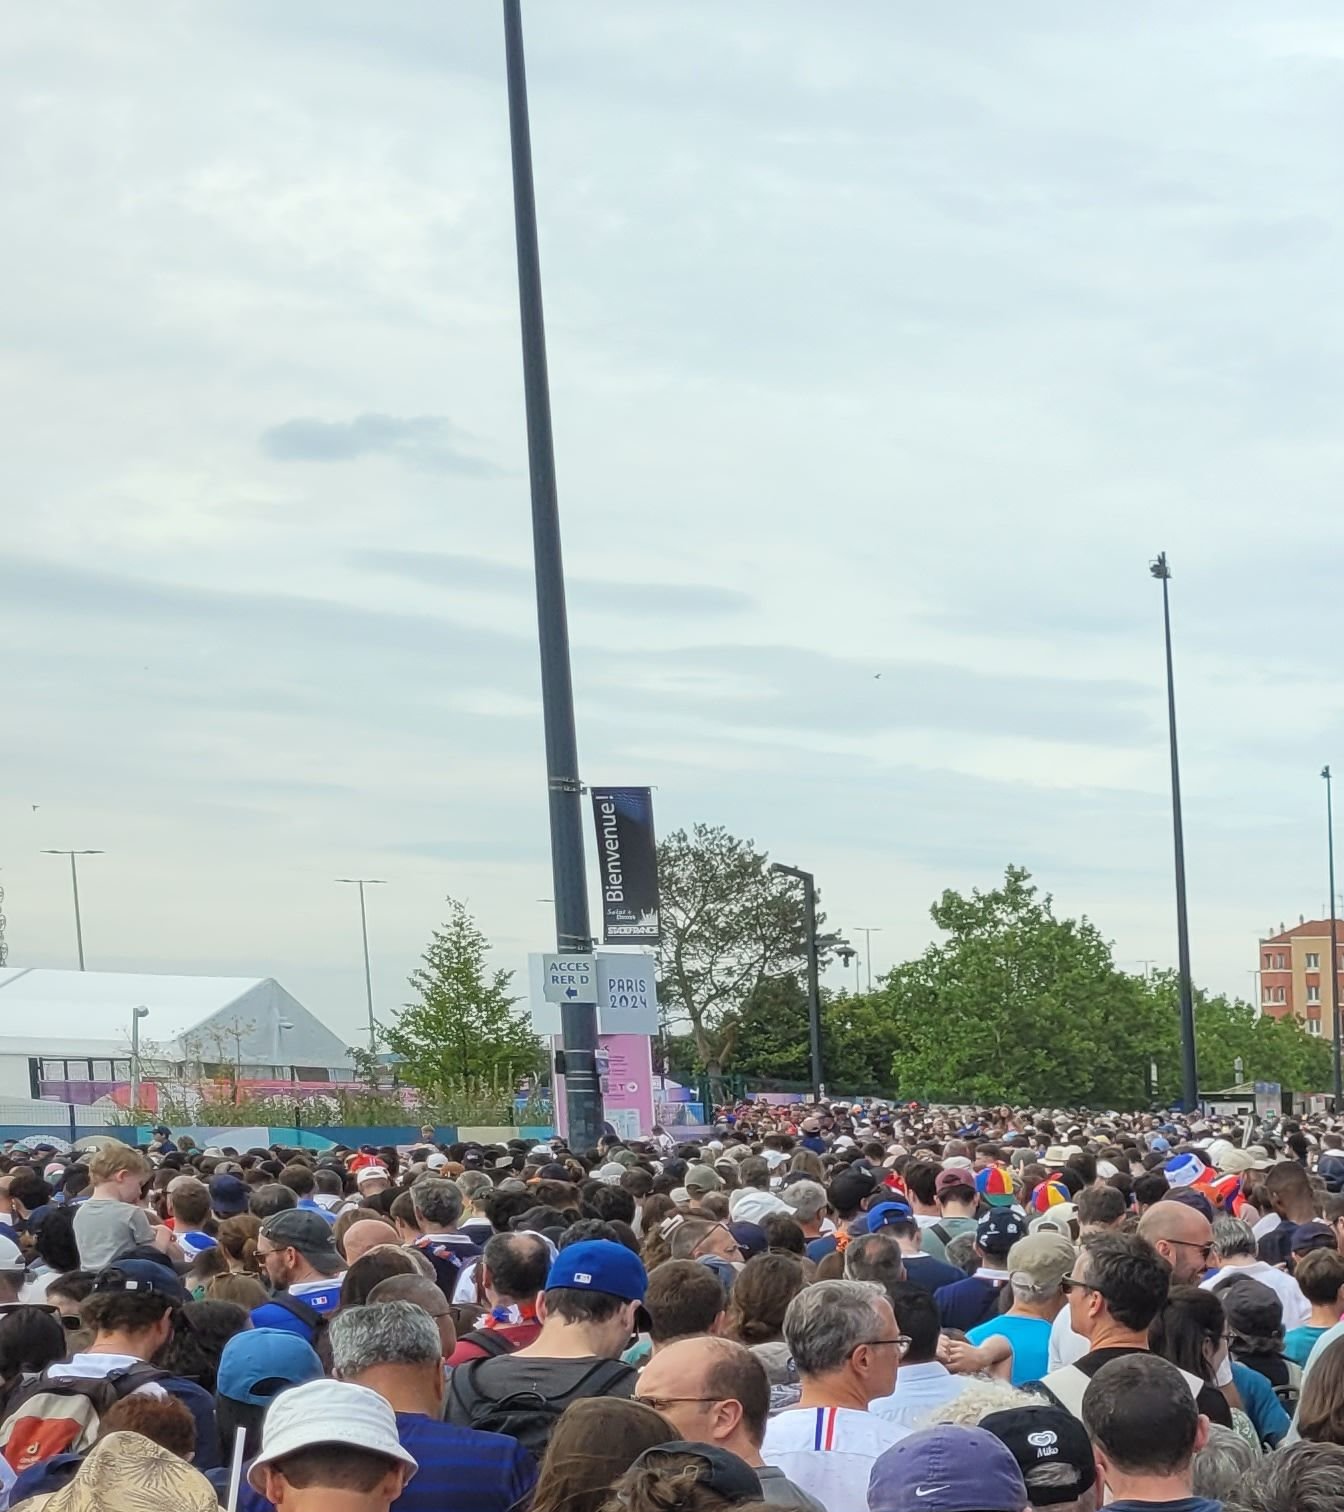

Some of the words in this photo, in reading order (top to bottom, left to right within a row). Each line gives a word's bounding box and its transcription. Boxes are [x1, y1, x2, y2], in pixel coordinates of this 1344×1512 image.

[595, 794, 624, 902] Bienvenue!
[549, 961, 590, 972] ACCES
[551, 974, 576, 985] RER
[580, 974, 590, 985] D
[608, 978, 646, 993] PARIS
[609, 995, 648, 1009] 2024
